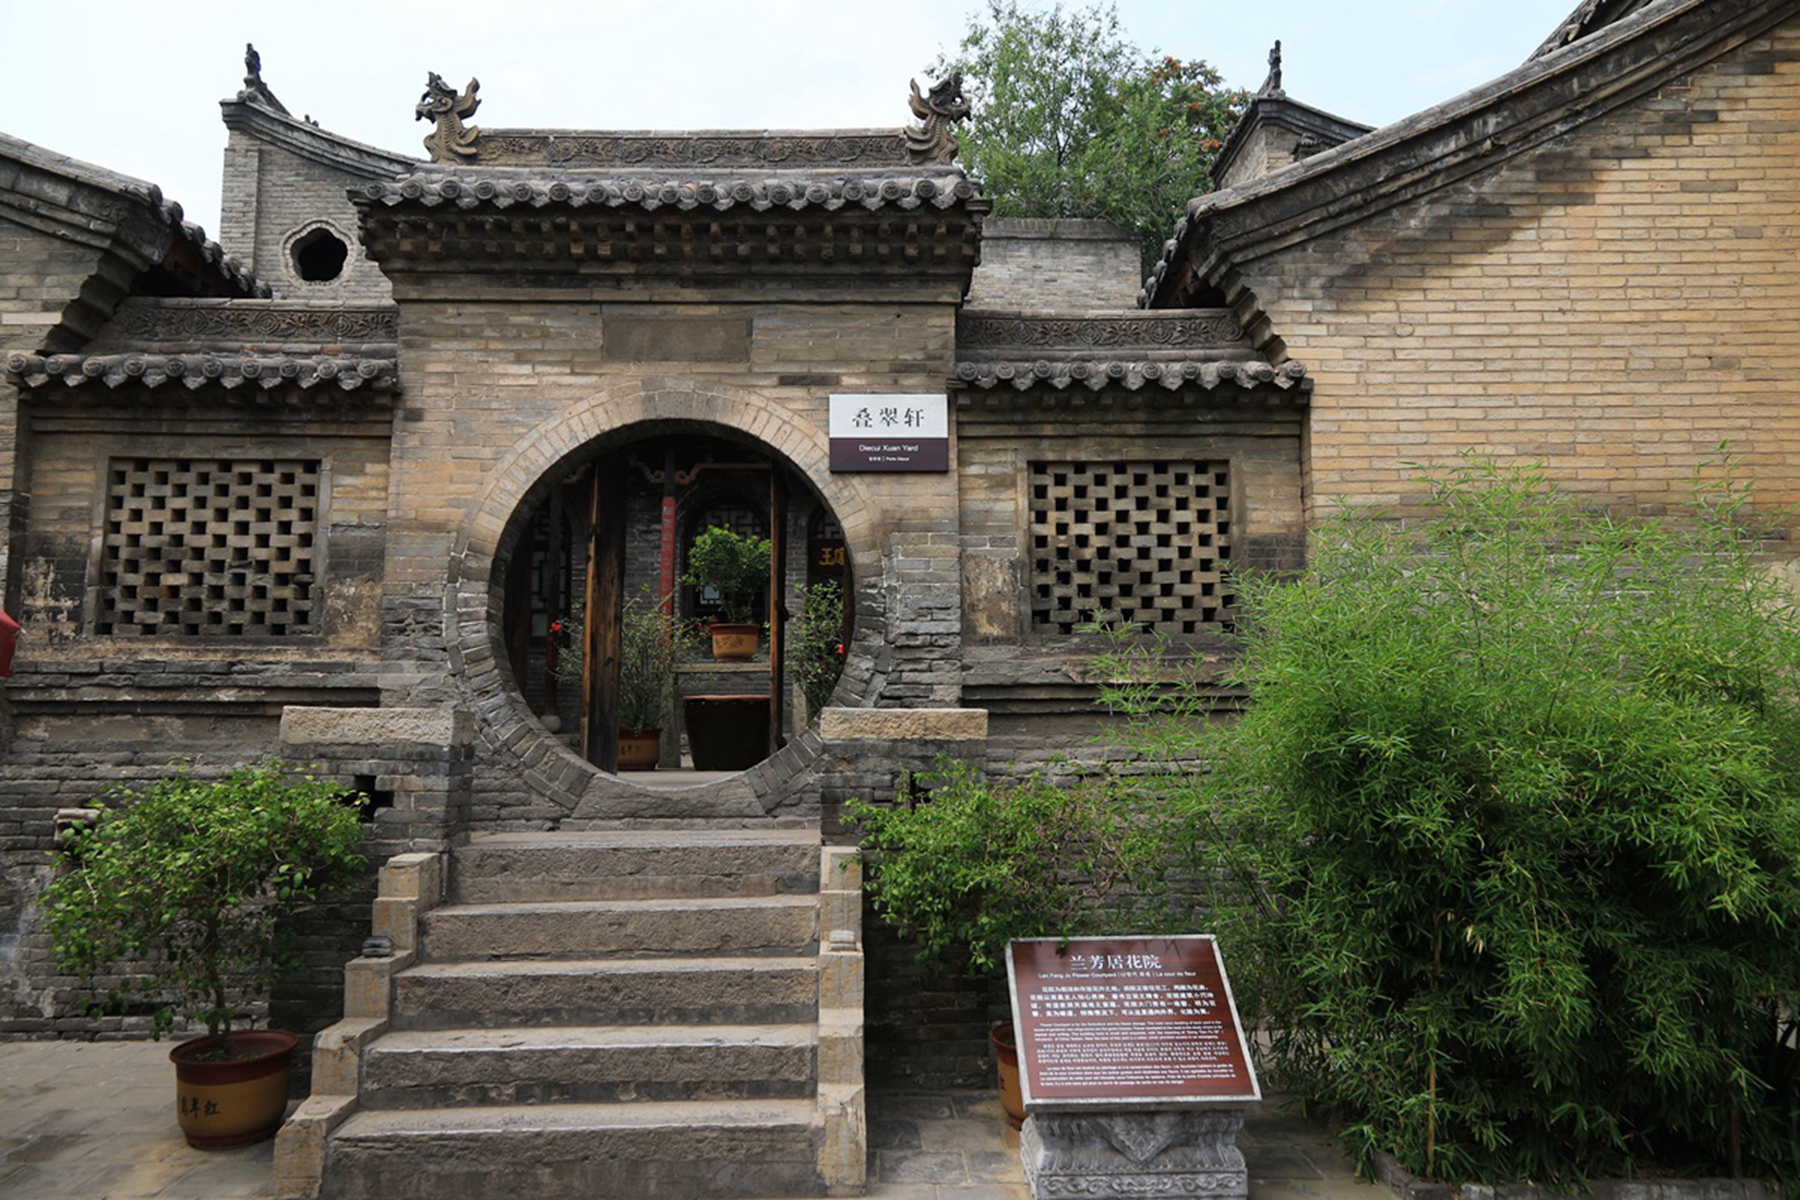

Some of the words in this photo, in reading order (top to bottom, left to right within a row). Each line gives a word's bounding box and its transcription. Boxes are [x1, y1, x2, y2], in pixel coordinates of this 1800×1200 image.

[852, 407, 925, 428] 叠翠轩
[859, 444, 881, 452] Diecui
[882, 444, 901, 452] Xuan
[902, 444, 919, 452] Yard
[1069, 954, 1162, 971] 兰芳居花院
[1091, 971, 1117, 979] Courtyard
